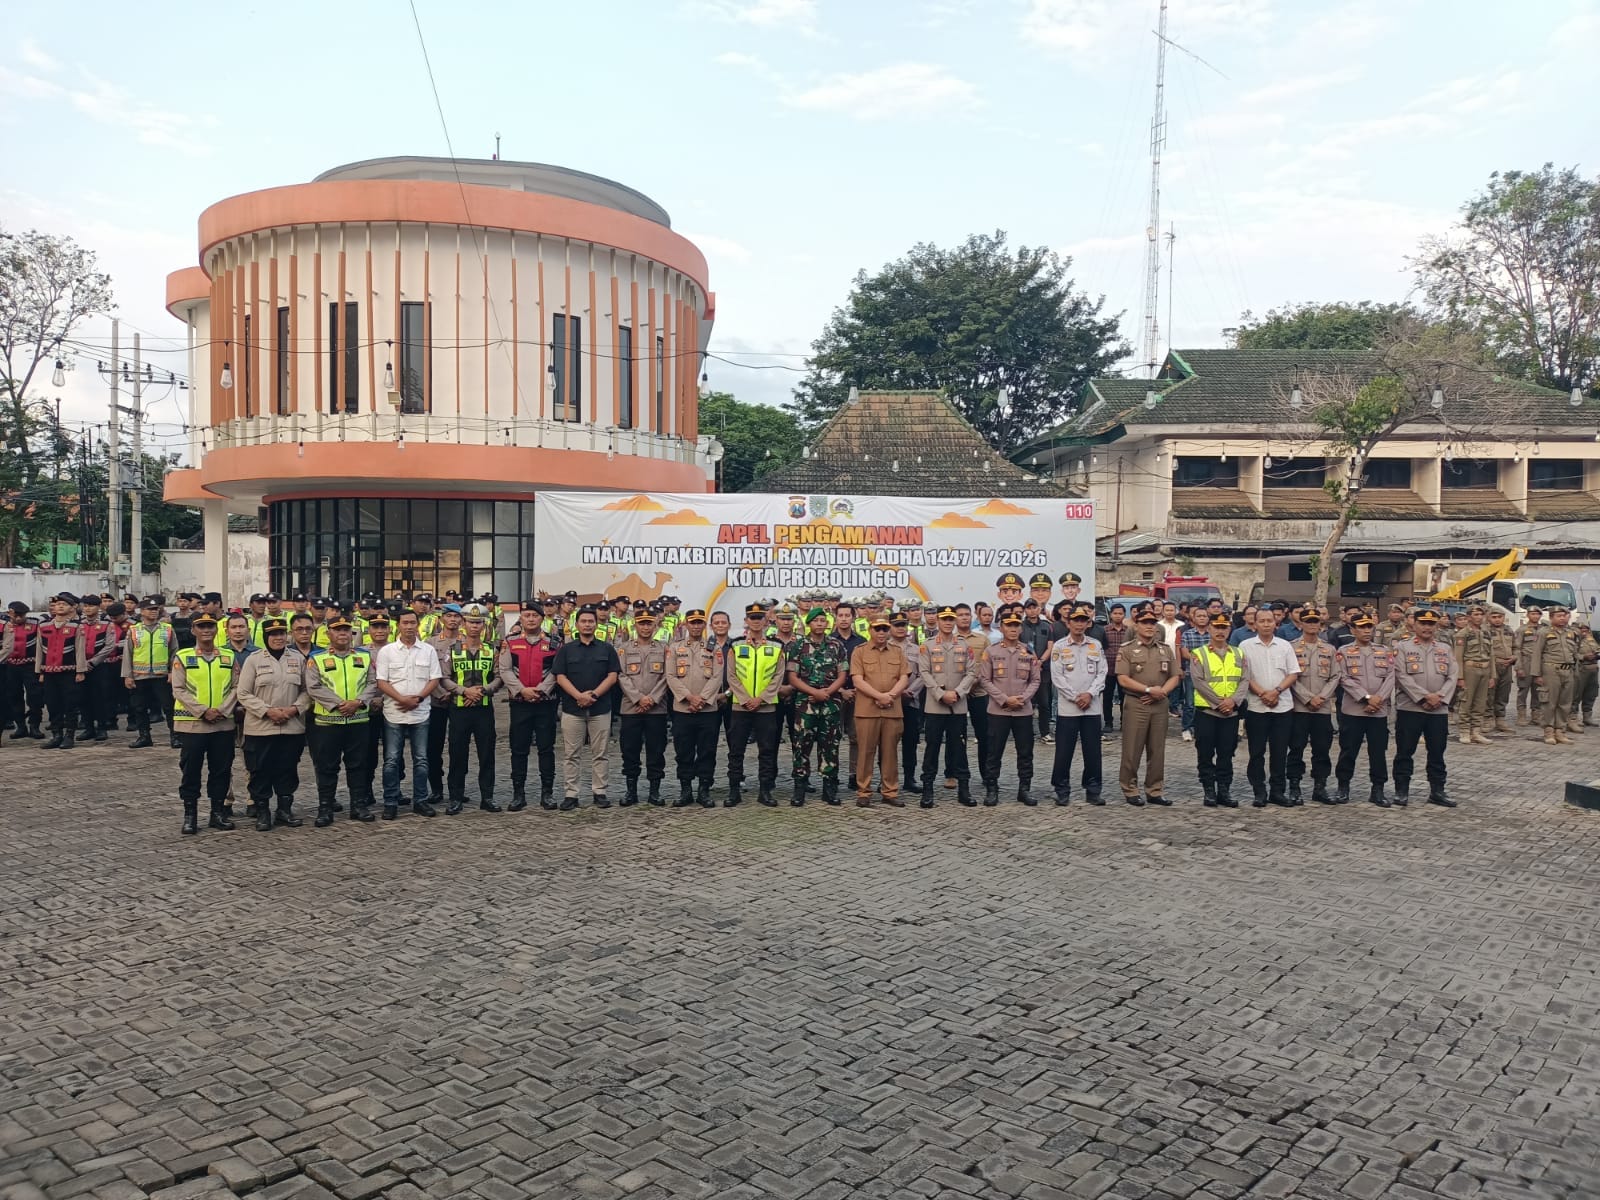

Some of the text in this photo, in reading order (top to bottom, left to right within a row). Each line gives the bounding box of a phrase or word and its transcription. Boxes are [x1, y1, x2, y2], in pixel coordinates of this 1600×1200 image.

[1066, 504, 1092, 518] 110
[717, 524, 923, 545] APEL PENGAMANAN
[583, 546, 652, 564] MALAM
[656, 546, 725, 564] TAKBIR
[728, 547, 775, 565] HARI
[777, 547, 826, 565] RAYA
[829, 547, 872, 566] IDUL
[874, 548, 926, 566] ADHA
[928, 549, 970, 566] 1447
[998, 550, 1047, 567] 2026
[727, 567, 911, 589] KOTA PROBOLINGGO
[454, 661, 492, 670] POLISI
